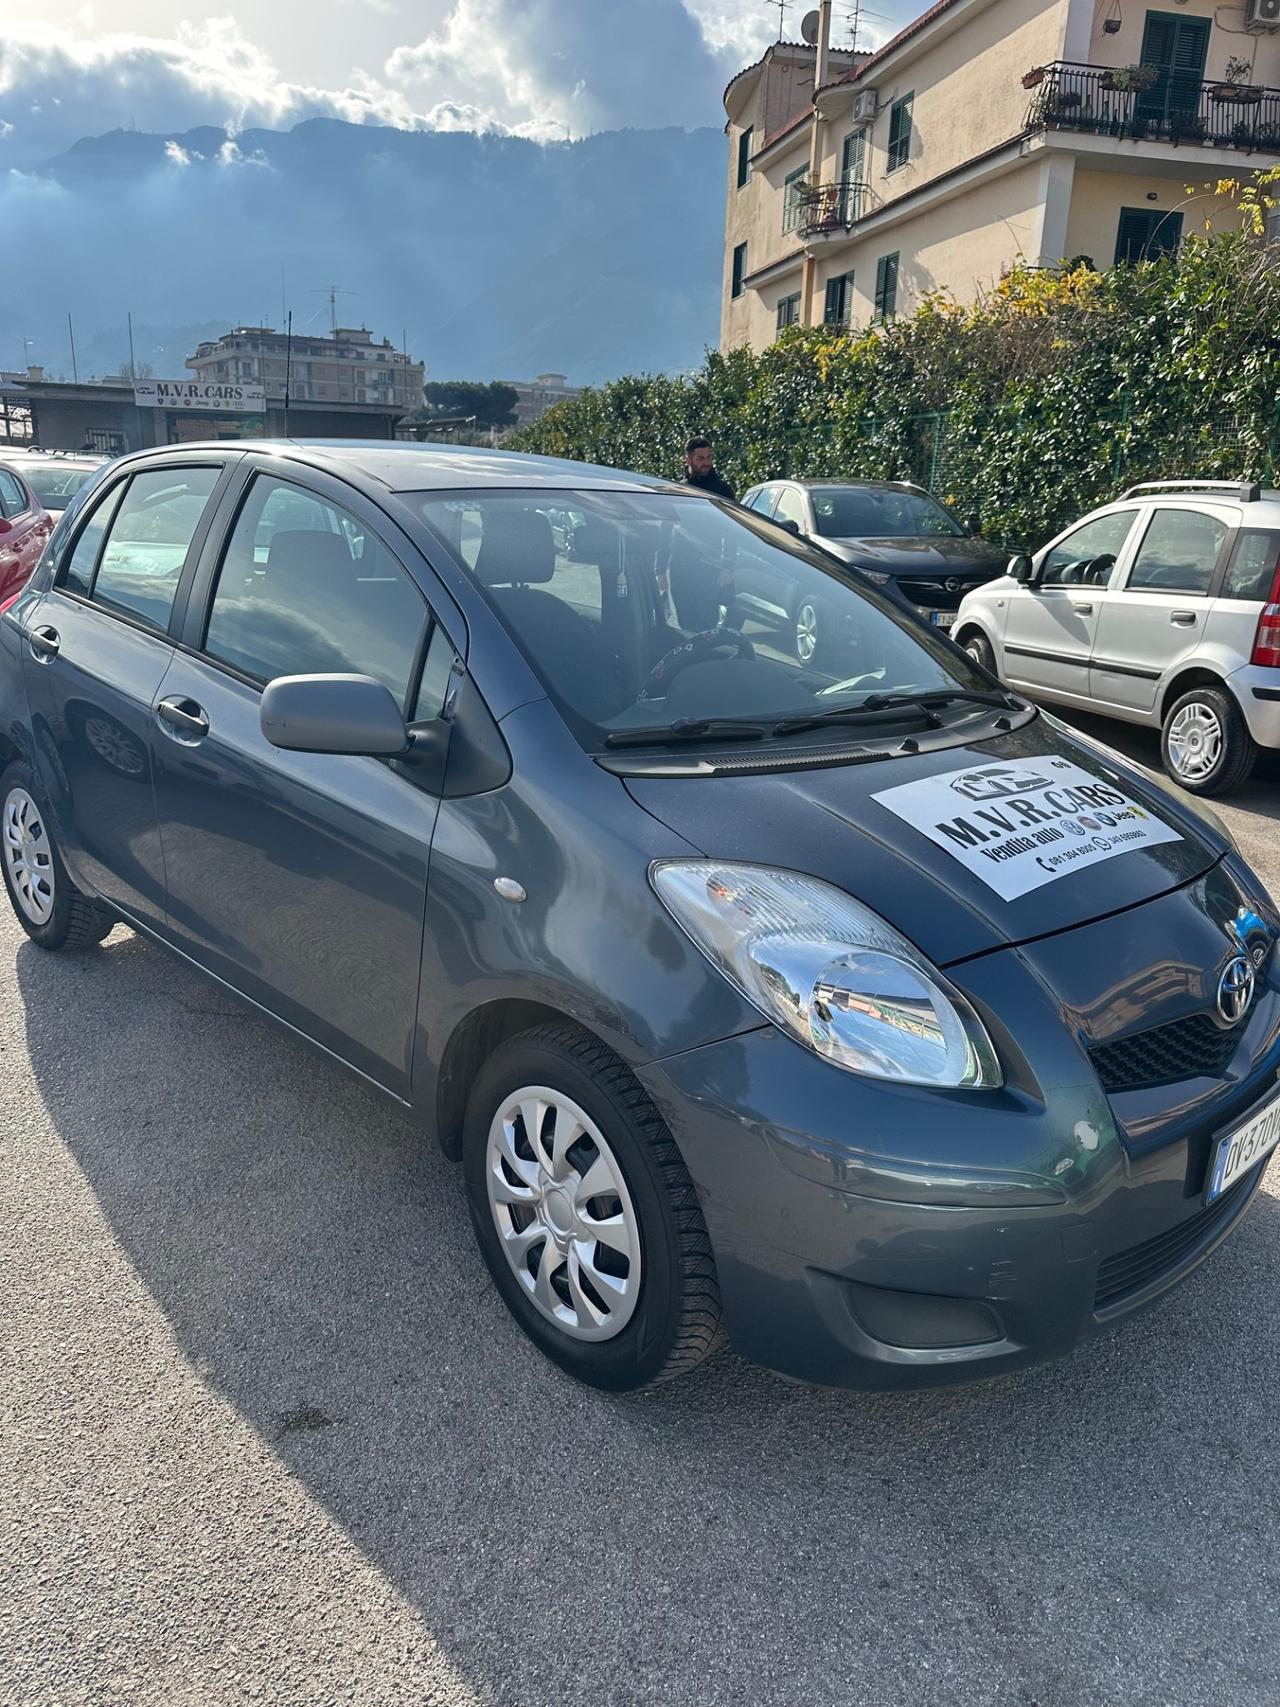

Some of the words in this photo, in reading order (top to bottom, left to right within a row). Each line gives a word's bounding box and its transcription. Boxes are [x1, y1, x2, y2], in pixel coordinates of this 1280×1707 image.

[157, 383, 243, 399] M.V.R.CARS
[935, 783, 1126, 850] M.V.R.CARS
[980, 831, 1038, 864] Vendita
[1036, 827, 1065, 847] auto
[1048, 855, 1066, 866] 081
[1063, 849, 1080, 860] 304
